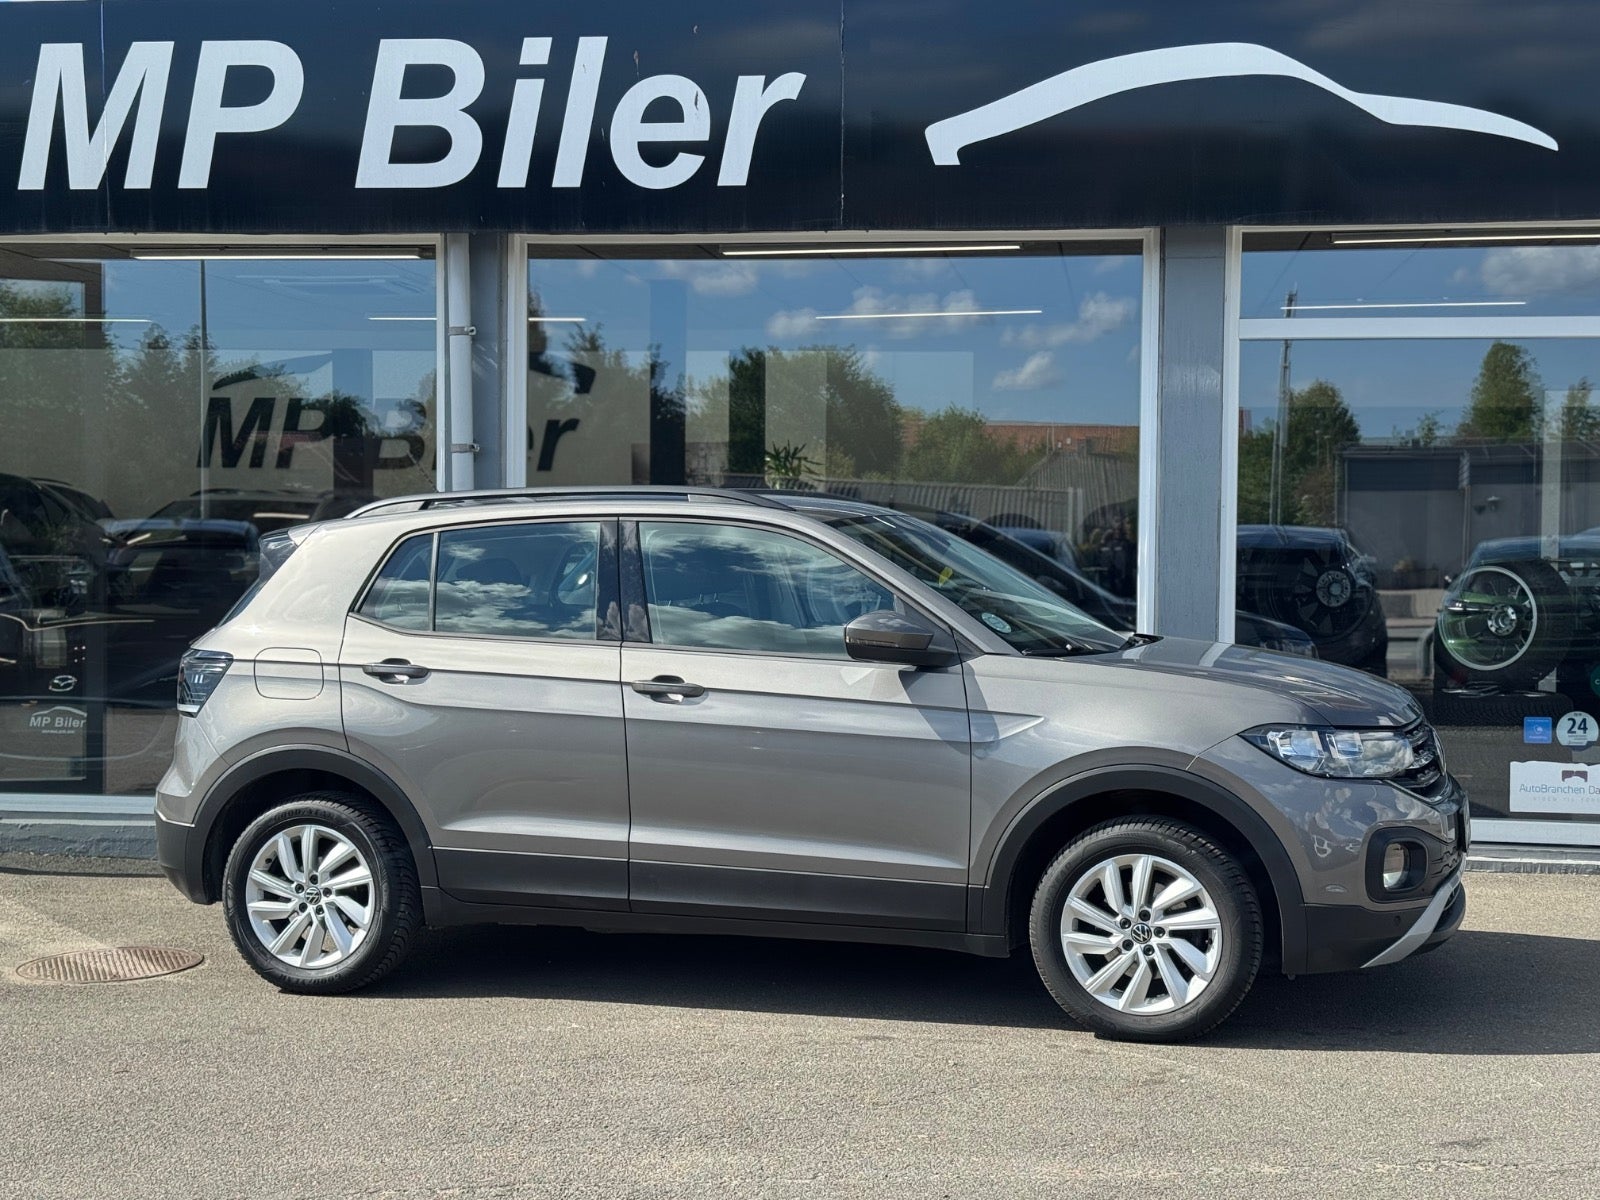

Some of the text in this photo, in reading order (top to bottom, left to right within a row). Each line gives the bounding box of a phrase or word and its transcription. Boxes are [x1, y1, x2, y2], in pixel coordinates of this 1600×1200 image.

[17, 36, 806, 190] MP Biler
[197, 397, 334, 469] MP
[29, 716, 87, 728] MP Biler
[1567, 717, 1588, 734] 24
[1519, 783, 1585, 794] AutoBranchen
